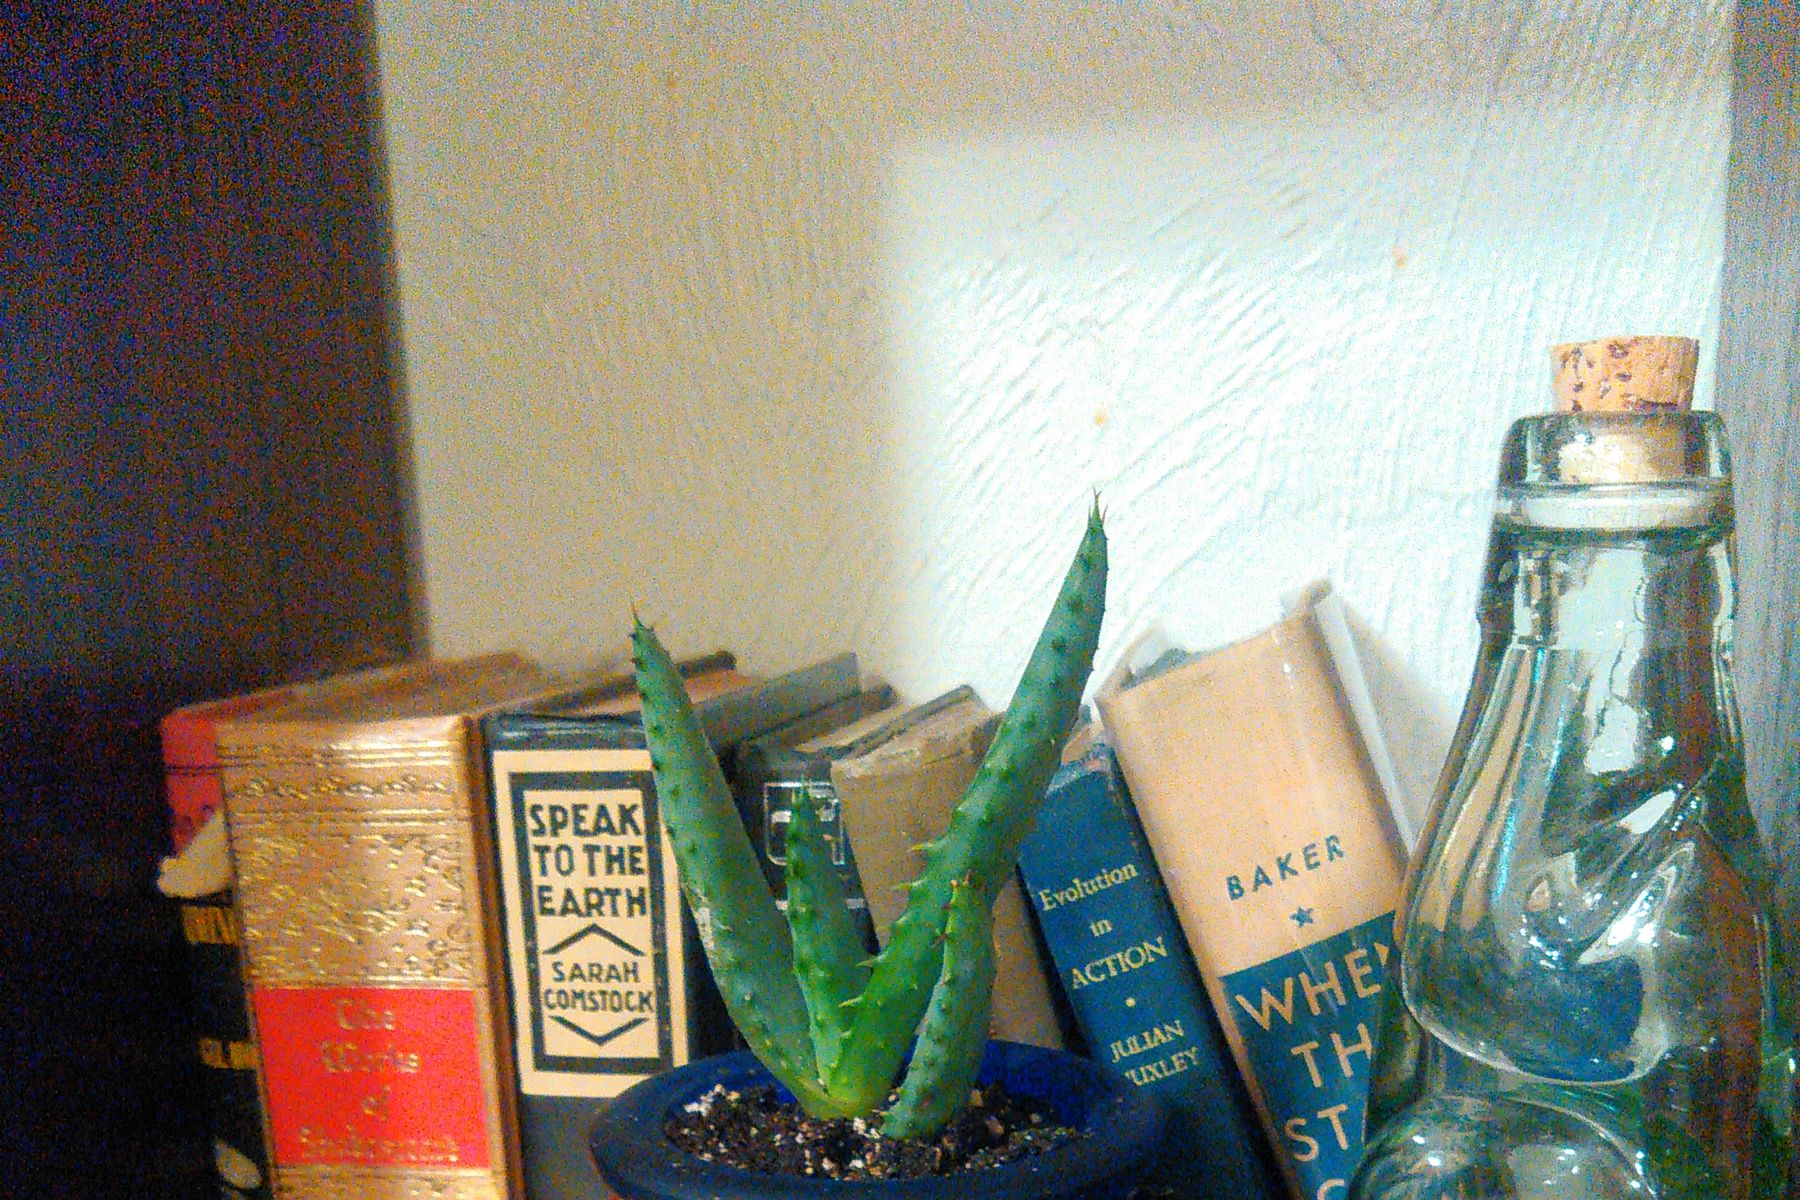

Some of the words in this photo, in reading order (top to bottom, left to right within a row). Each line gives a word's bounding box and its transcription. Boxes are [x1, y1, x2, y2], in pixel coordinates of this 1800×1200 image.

[530, 803, 641, 837] SPEAK
[533, 843, 575, 877] TO
[583, 843, 645, 877] THE
[1226, 834, 1344, 901] BAKER
[537, 885, 647, 917] EARTH
[1038, 863, 1139, 911] Evolution
[1089, 918, 1113, 937] in
[551, 961, 640, 983] SARAH
[1071, 936, 1168, 990] ACTION
[543, 988, 653, 1012] COMSTOCK
[1234, 942, 1389, 1031] WHE
[1109, 1019, 1185, 1063] JULIAN
[1124, 1046, 1200, 1087] UXLEY
